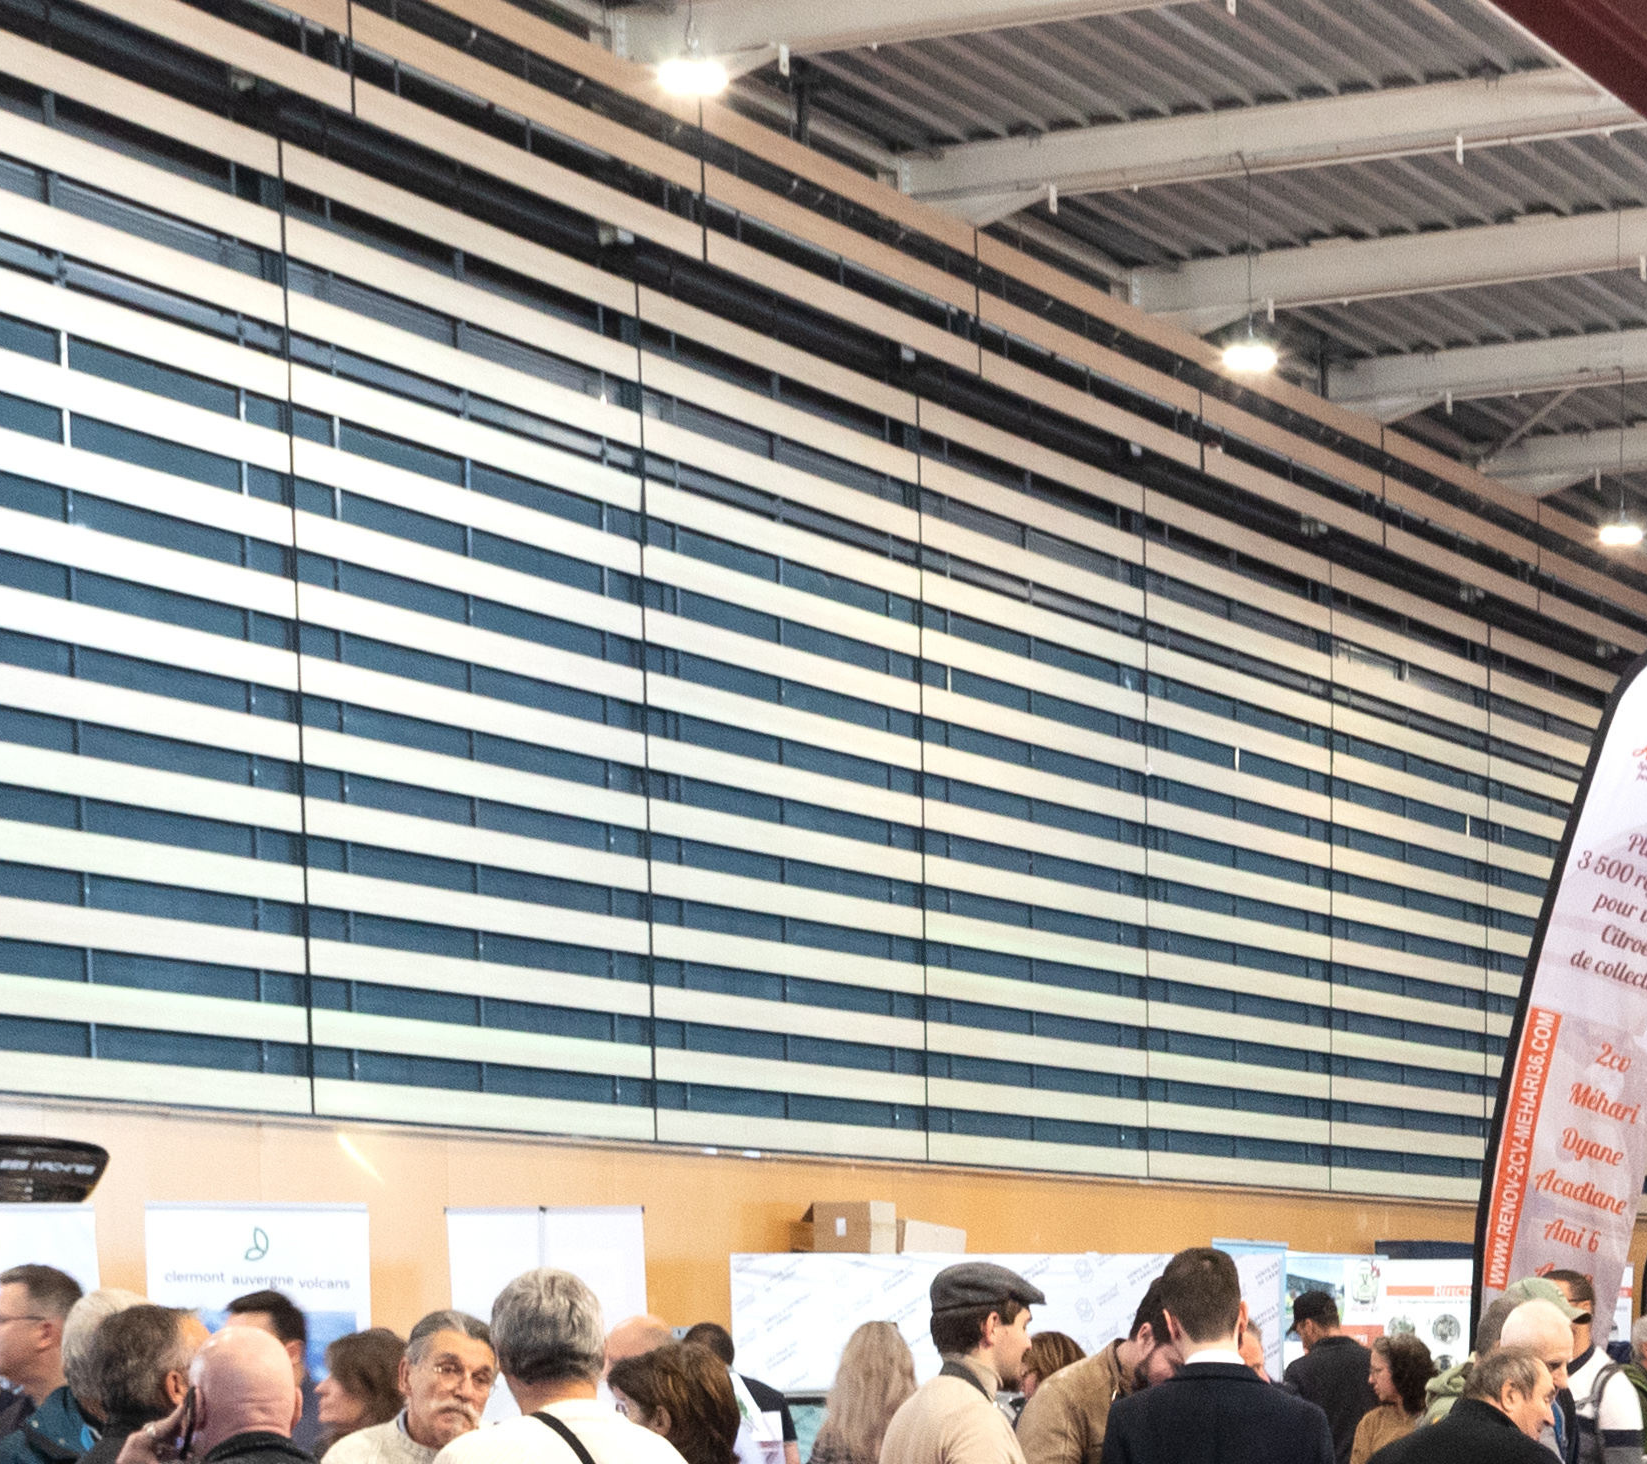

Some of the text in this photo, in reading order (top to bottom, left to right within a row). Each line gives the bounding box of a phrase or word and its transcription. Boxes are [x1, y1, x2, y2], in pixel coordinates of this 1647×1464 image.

[1593, 856, 1633, 885] 500
[1592, 892, 1638, 921] pour
[1570, 949, 1592, 970] de
[1595, 1042, 1632, 1072] 2cv
[1568, 1081, 1641, 1125] Méhari
[1562, 1127, 1625, 1168] Dyane
[1535, 1169, 1628, 1216] Acadiane
[1543, 1219, 1587, 1251] Ami
[164, 1270, 351, 1291] clermont auvergne volcans
